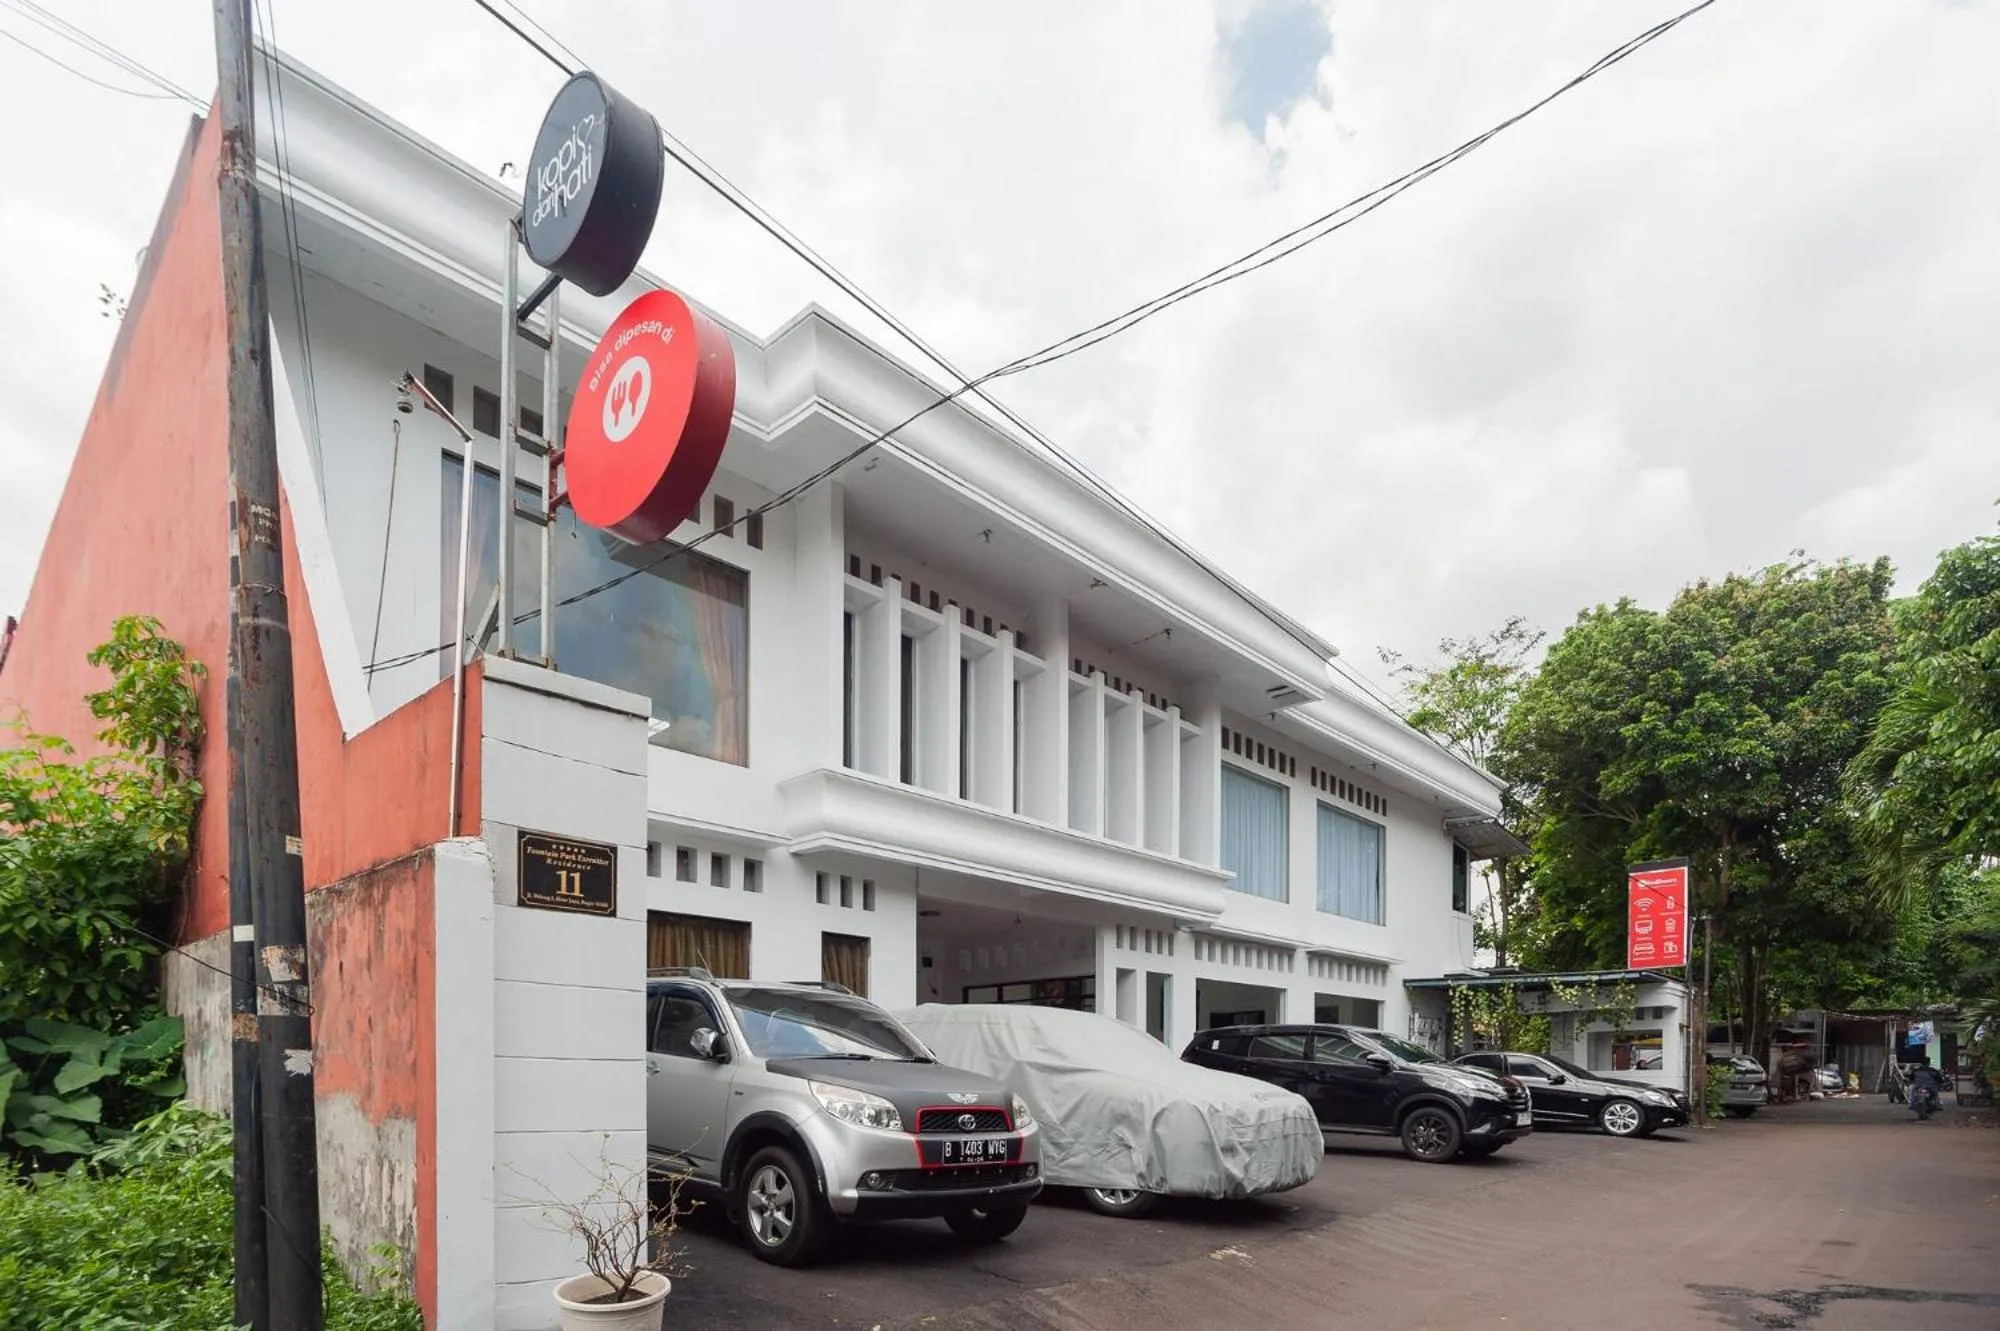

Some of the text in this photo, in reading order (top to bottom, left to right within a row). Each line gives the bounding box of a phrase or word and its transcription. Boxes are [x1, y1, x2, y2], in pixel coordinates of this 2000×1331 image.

[537, 124, 577, 200] kopi
[553, 142, 592, 218] hati
[614, 320, 663, 352] dipesan
[661, 326, 676, 345] di
[555, 870, 585, 897] 11
[945, 1140, 1005, 1157] B 1403 WYG
